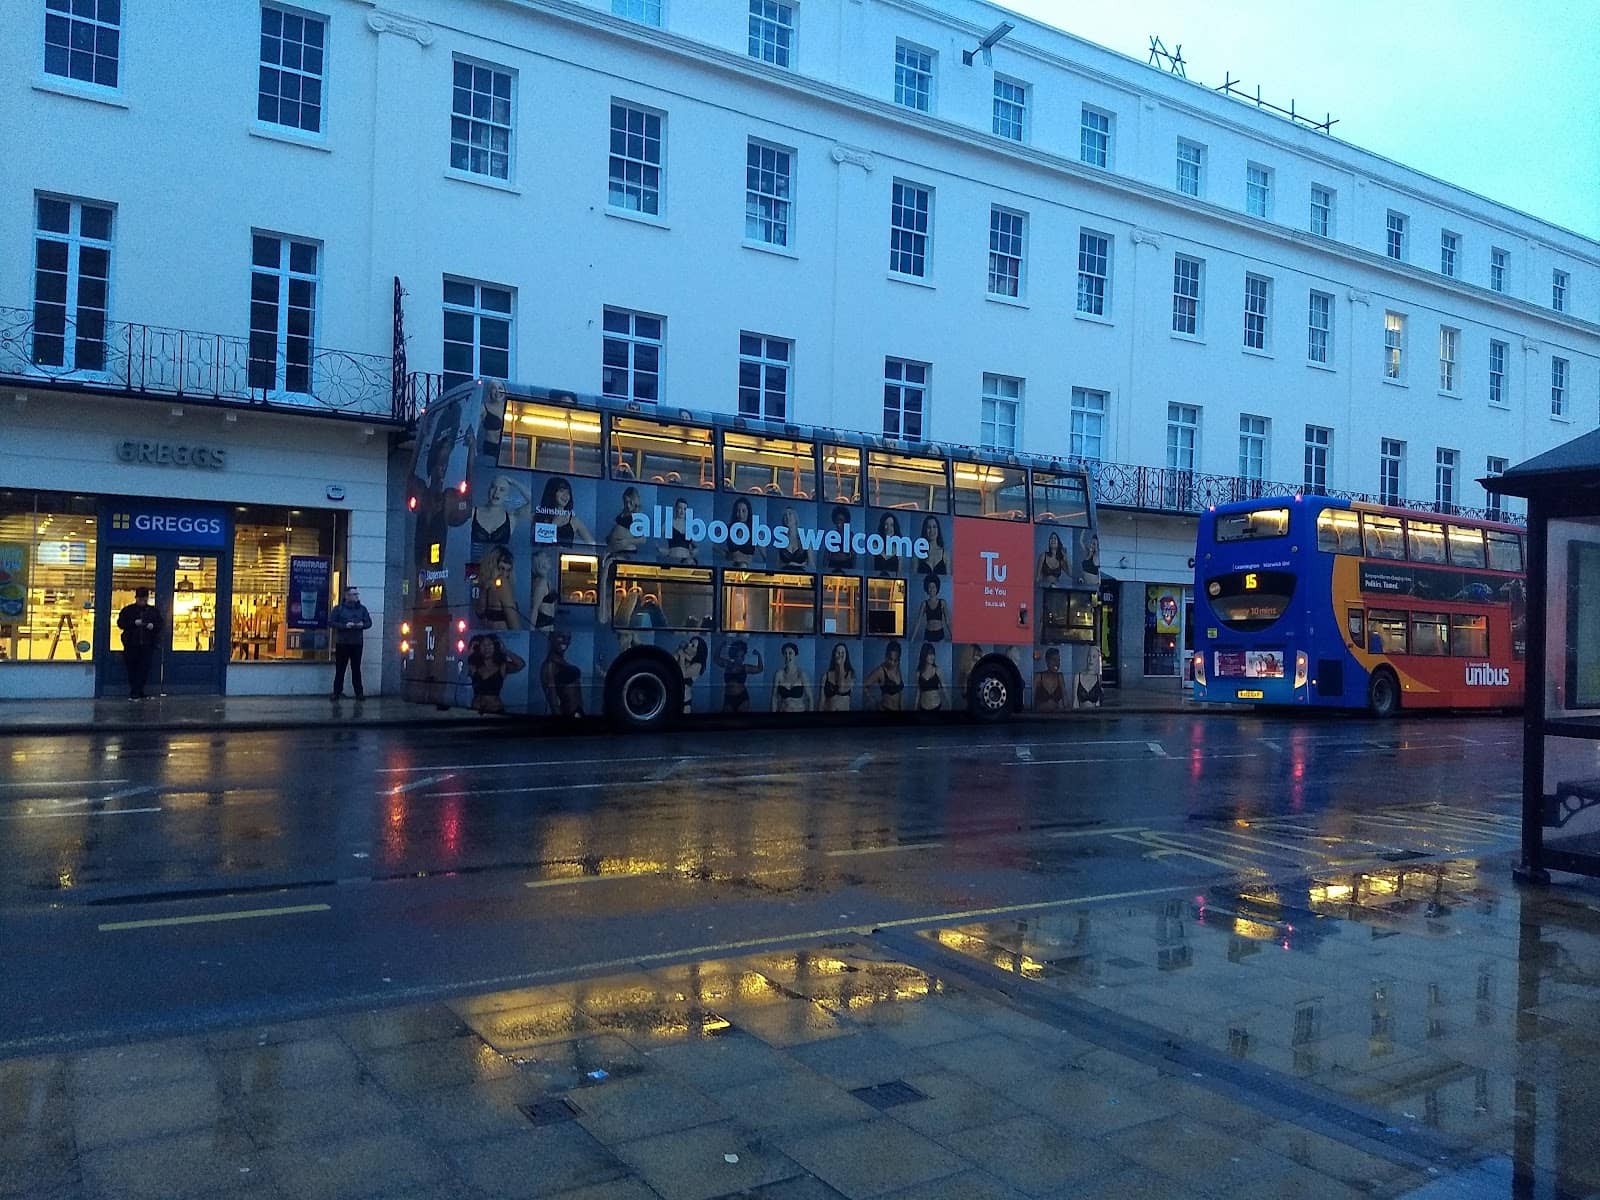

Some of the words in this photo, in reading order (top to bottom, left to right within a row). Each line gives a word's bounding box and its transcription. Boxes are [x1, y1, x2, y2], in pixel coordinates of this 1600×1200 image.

[116, 440, 226, 472] GREGGS
[135, 514, 220, 534] GREGGS
[629, 505, 673, 539] all
[685, 508, 790, 548] boobs
[798, 523, 930, 559] welcome
[980, 551, 1007, 582] Tu
[994, 587, 1007, 596] You
[425, 626, 435, 650] Tu
[1465, 662, 1510, 686] unibus
